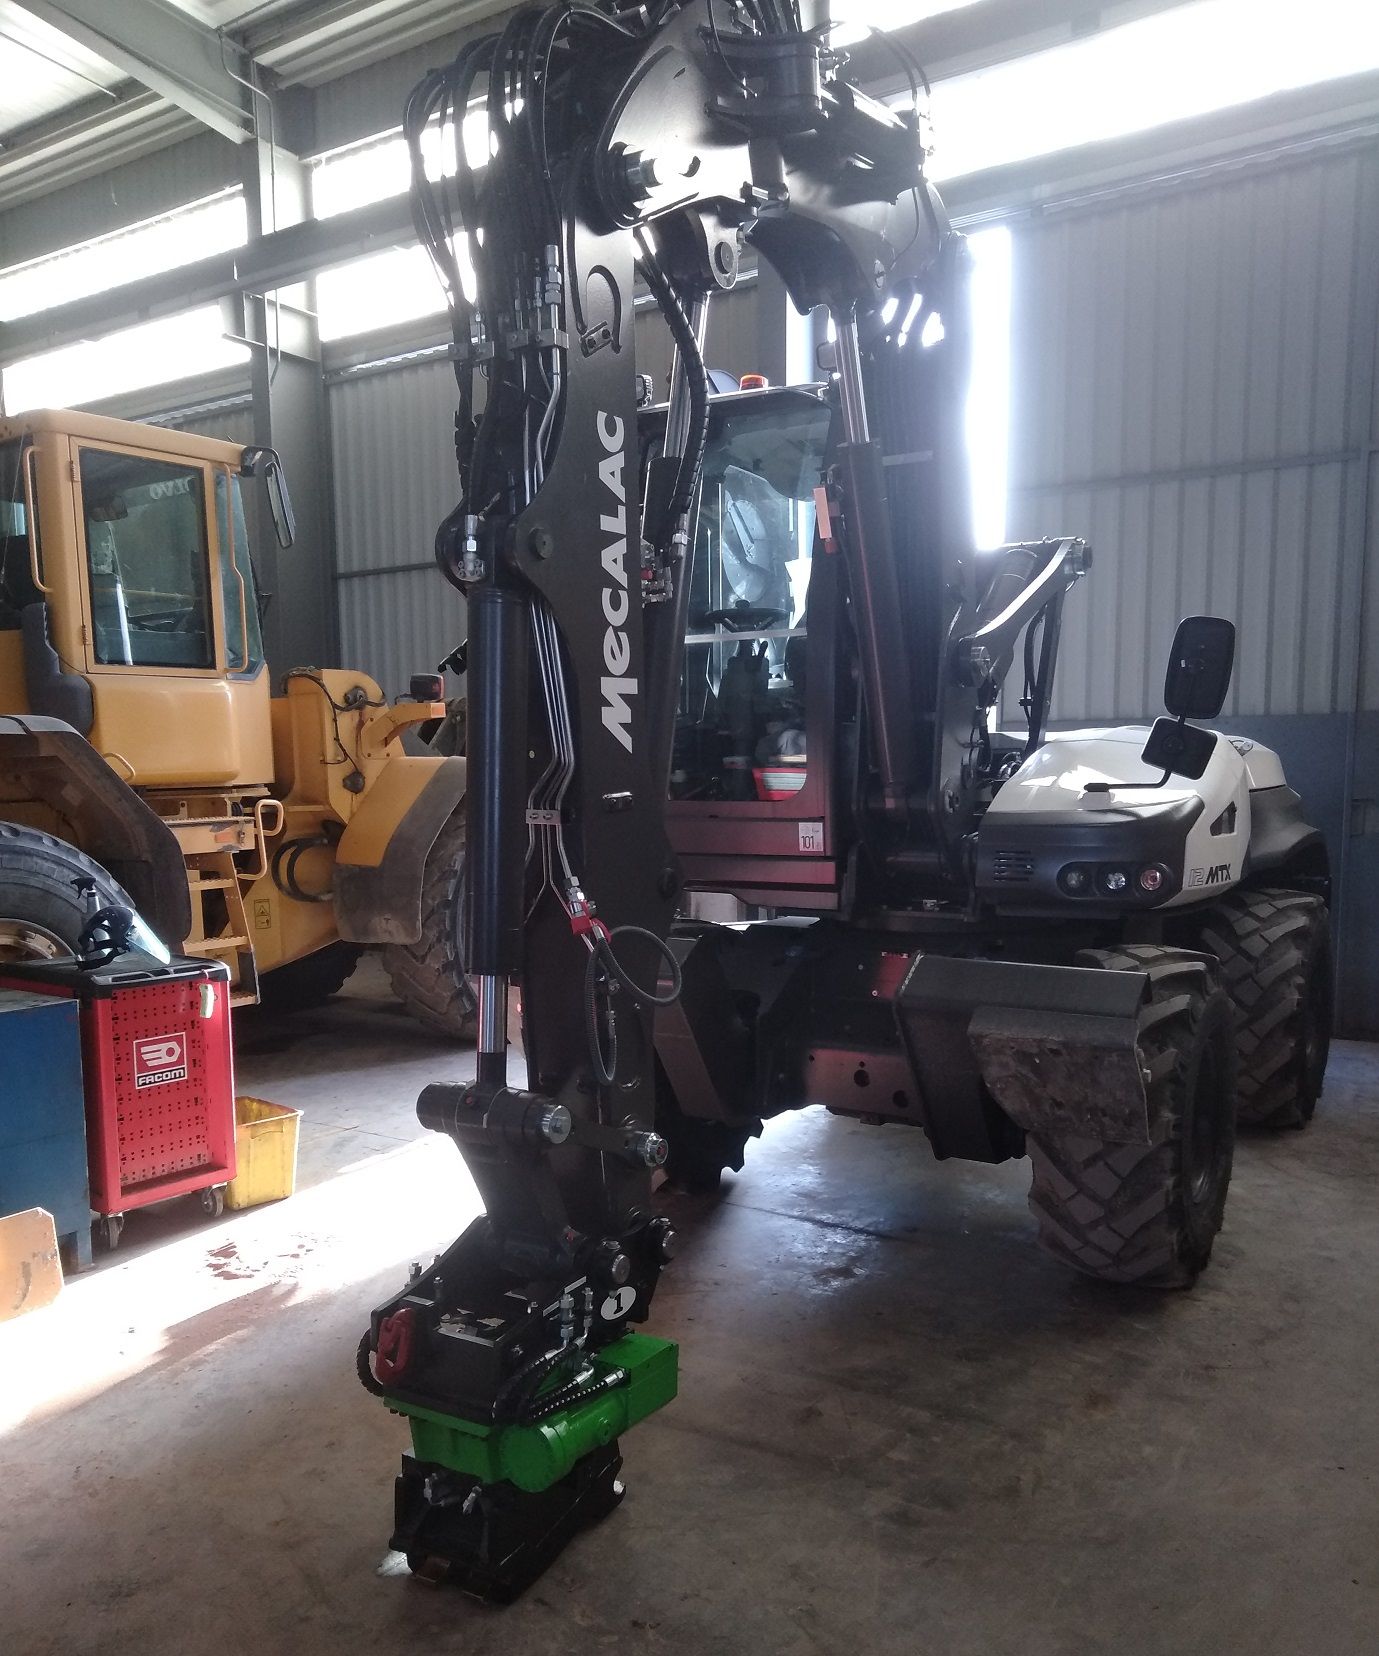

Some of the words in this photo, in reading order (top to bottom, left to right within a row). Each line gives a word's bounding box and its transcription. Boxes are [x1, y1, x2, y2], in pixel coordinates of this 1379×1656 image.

[801, 835, 814, 849] 101
[1205, 863, 1231, 885] MTX
[138, 1069, 184, 1086] FACOM
[613, 1292, 624, 1315] 1
